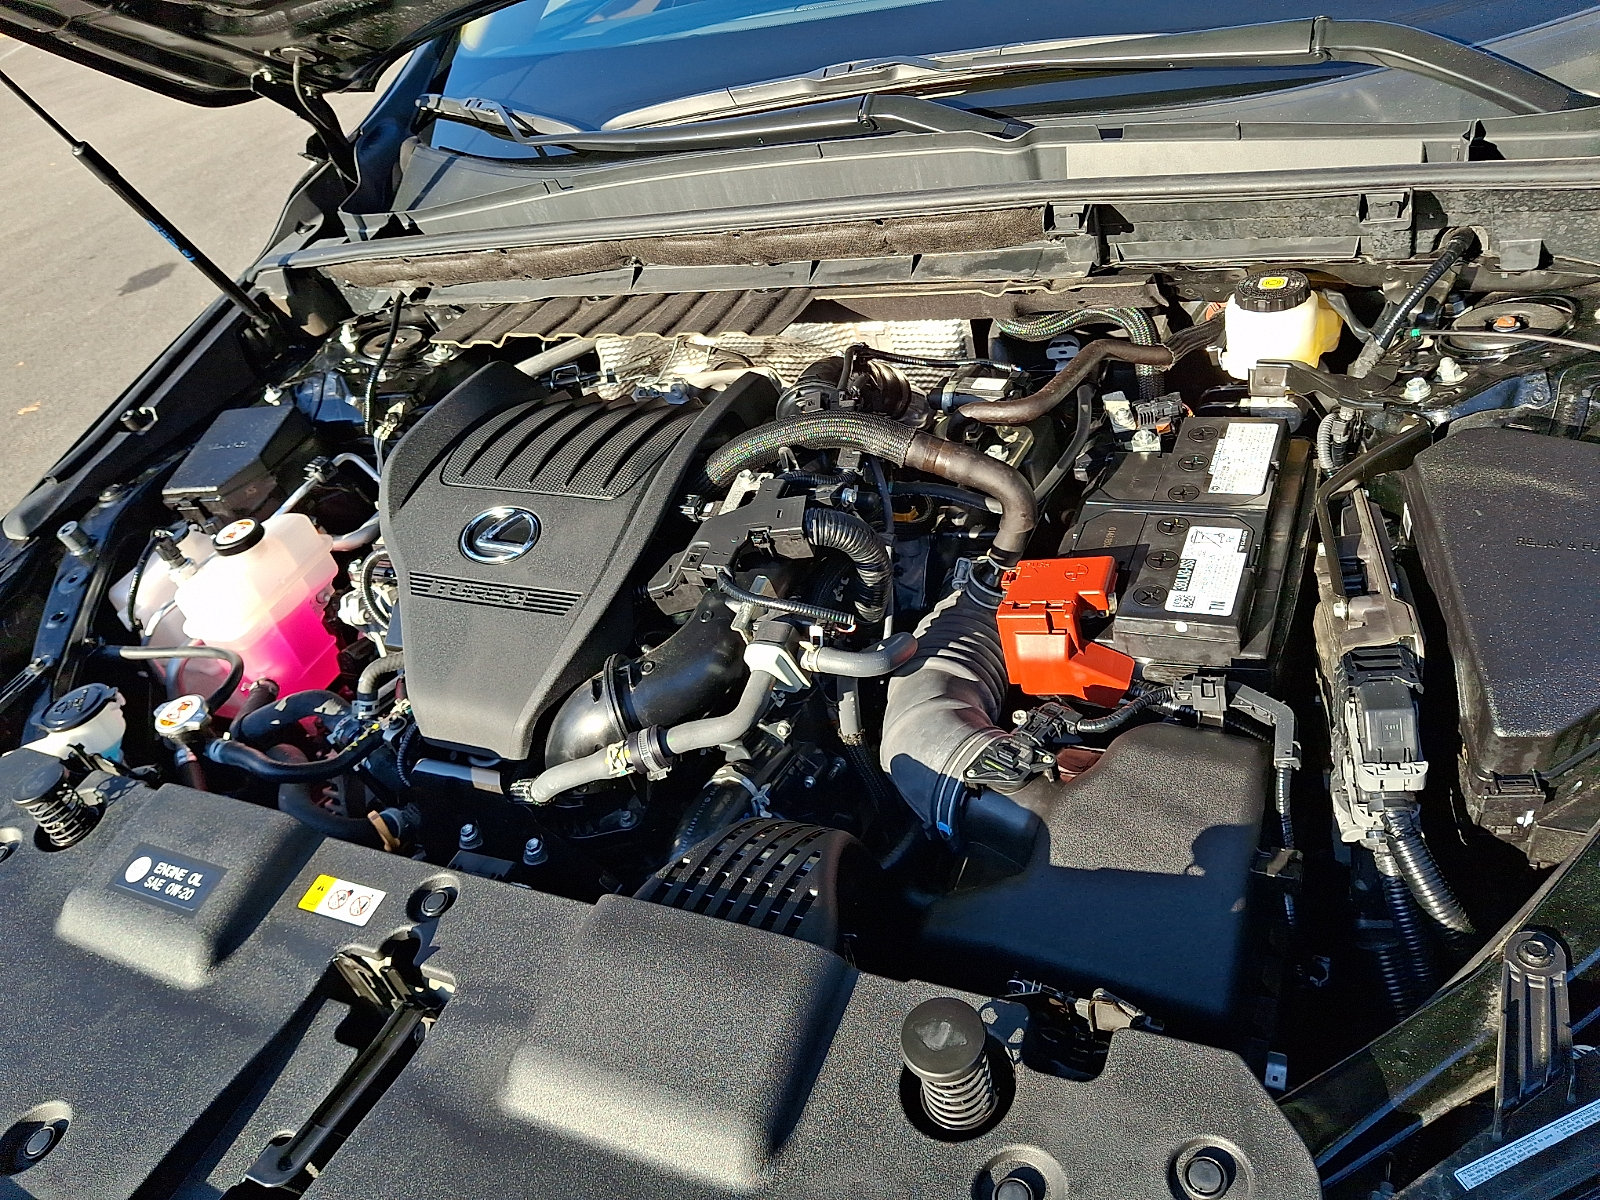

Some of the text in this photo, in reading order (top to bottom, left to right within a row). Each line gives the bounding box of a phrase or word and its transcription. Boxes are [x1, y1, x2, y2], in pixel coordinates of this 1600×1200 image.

[1515, 537, 1562, 549] RELAY
[428, 580, 528, 605] TURBO
[153, 861, 204, 888] ENGINE OIL
[143, 875, 196, 901] SAE 0W-20
